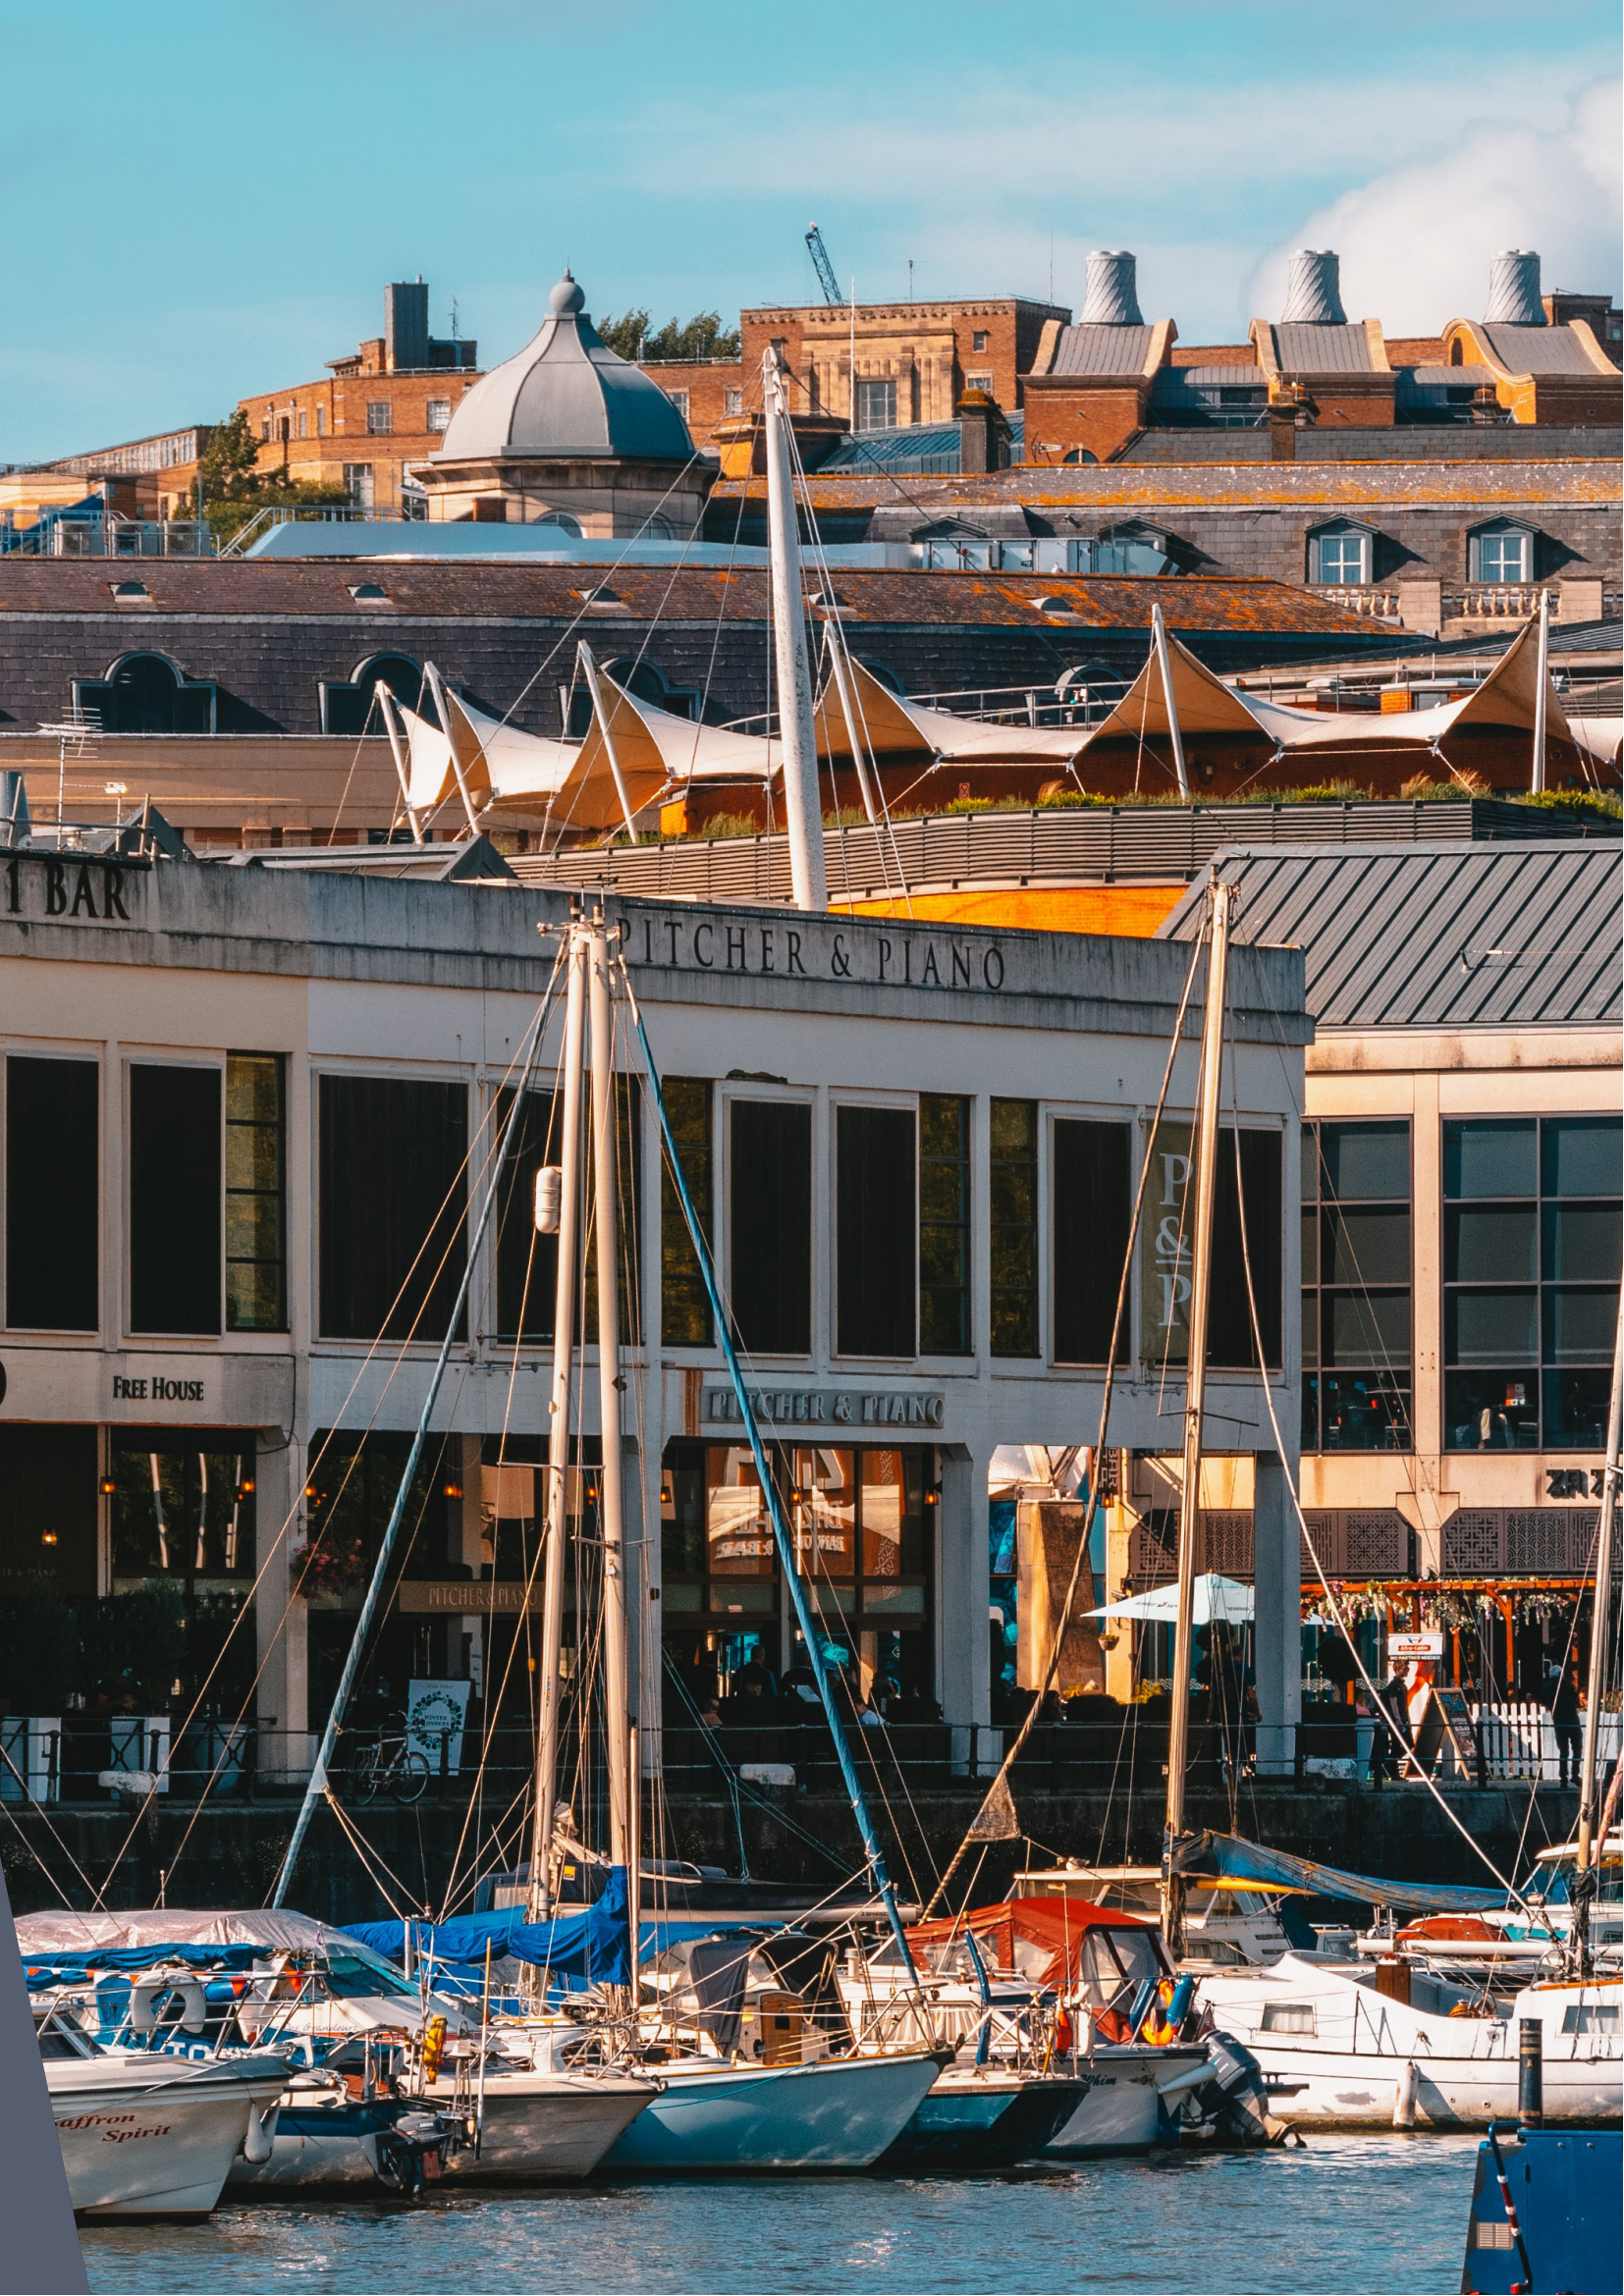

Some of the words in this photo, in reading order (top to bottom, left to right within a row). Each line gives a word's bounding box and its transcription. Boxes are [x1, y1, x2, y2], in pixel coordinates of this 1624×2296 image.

[45, 863, 131, 920] BAR
[616, 918, 806, 974] PITCHER
[831, 934, 852, 978] &
[877, 937, 1005, 990] PIANO
[1159, 1152, 1194, 1206] P
[1155, 1215, 1194, 1256] &
[1157, 1273, 1193, 1326] P
[113, 1375, 147, 1399] FREE
[151, 1376, 204, 1401] HOUSE
[711, 1392, 825, 1420] PITCHER
[836, 1394, 852, 1421] &
[864, 1395, 945, 1423] PIANO
[428, 1587, 484, 1606] PITCHER
[498, 1588, 538, 1606] PIANO
[101, 2125, 172, 2144] Spirit
